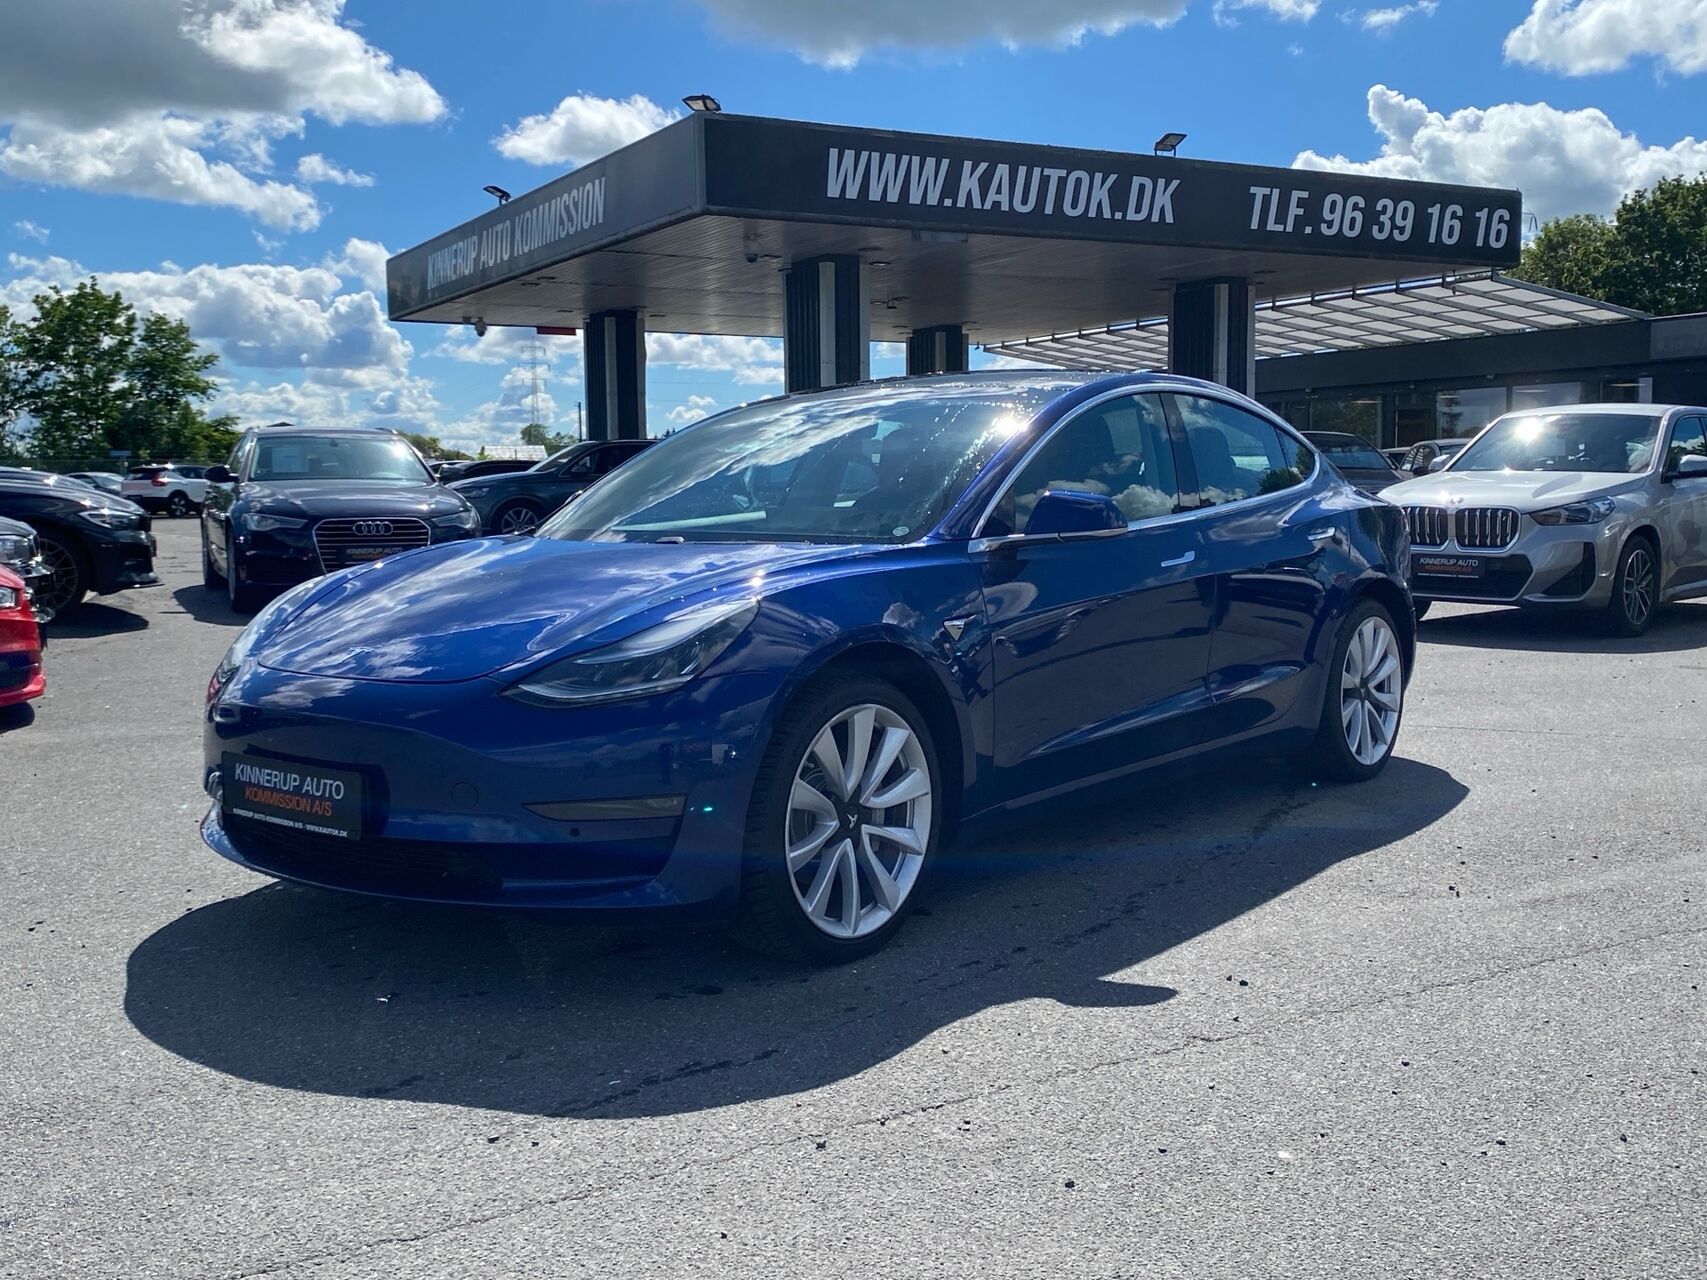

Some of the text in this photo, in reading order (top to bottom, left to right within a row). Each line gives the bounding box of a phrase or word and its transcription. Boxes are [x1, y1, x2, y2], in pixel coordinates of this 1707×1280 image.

[826, 147, 1181, 224] WWW.KAUTOK.DK
[427, 176, 606, 290] KINNERUP AUTO KOMMISSION
[1249, 186, 1511, 249] TLF. 96 39 16 16
[1457, 559, 1479, 567] AUTO
[235, 763, 344, 800] KINNERUP AUTO
[245, 787, 332, 816] KOMMISSION A/S
